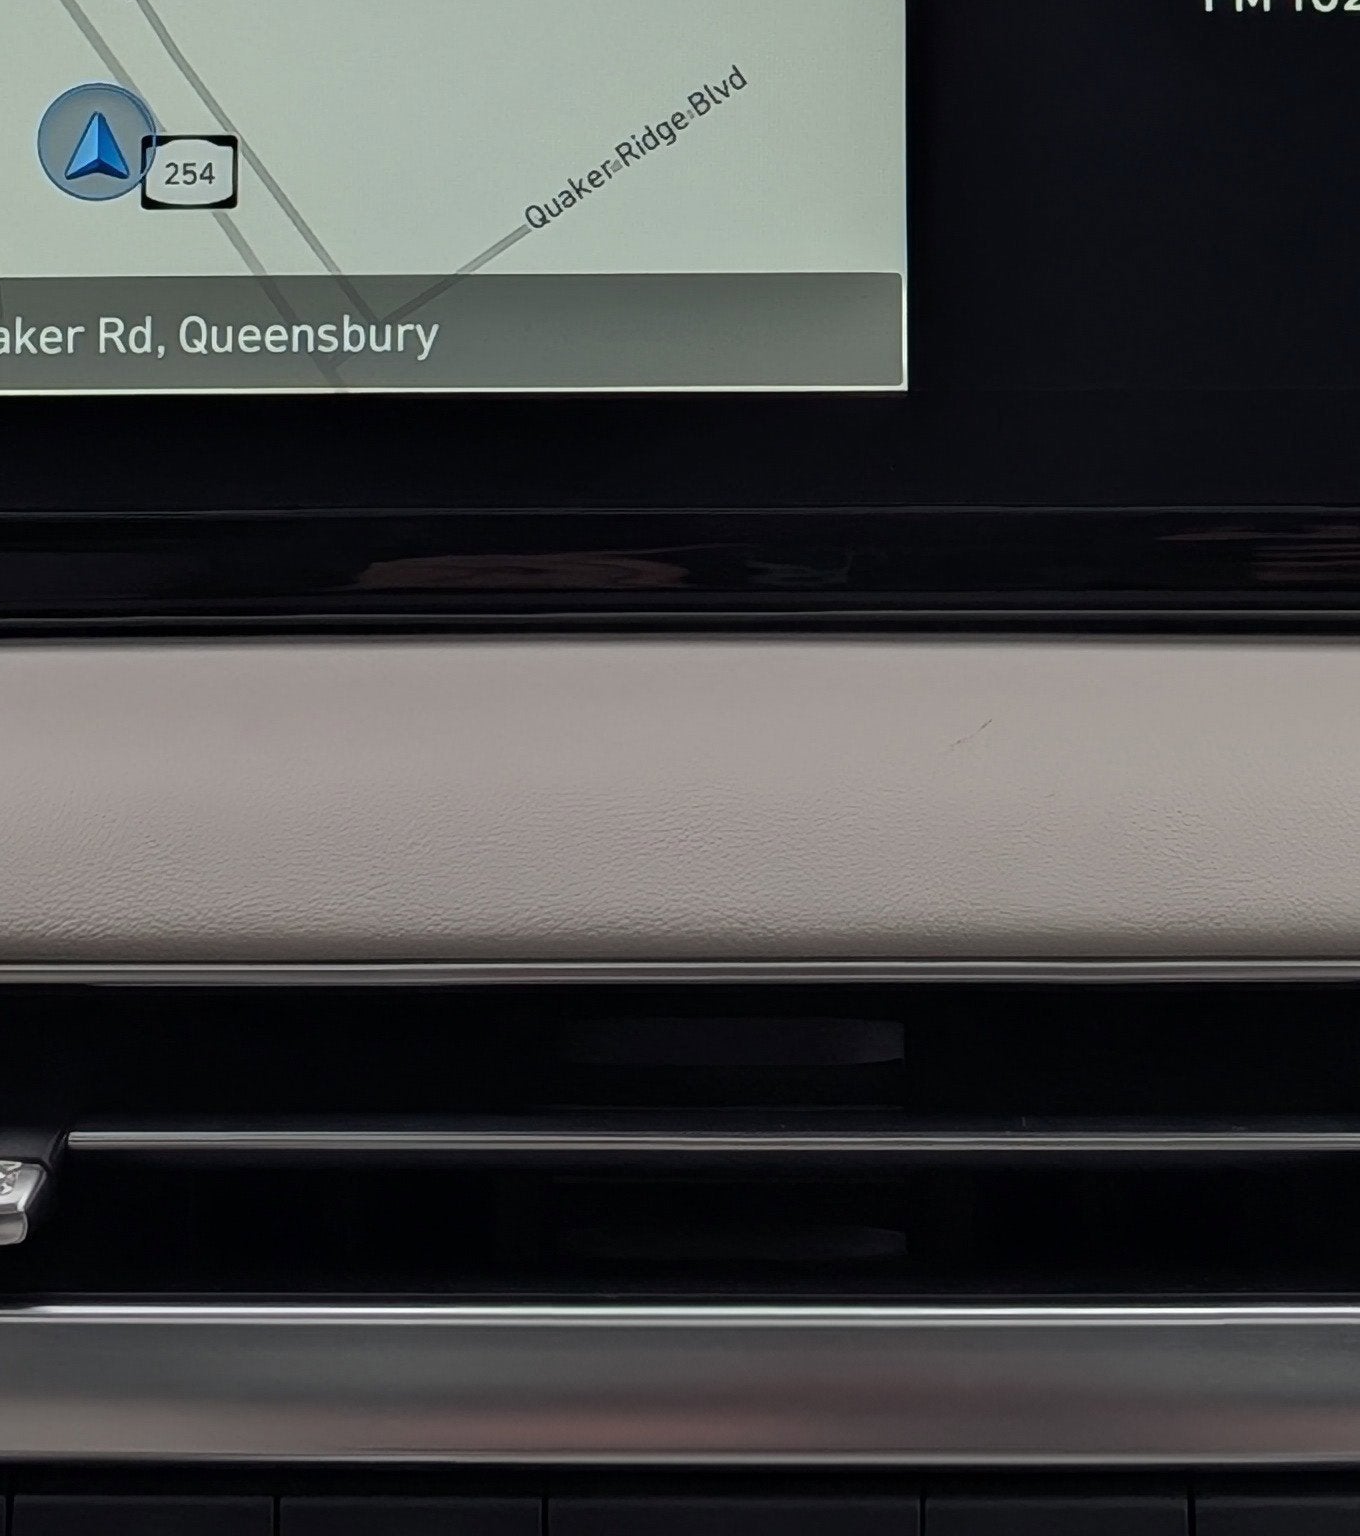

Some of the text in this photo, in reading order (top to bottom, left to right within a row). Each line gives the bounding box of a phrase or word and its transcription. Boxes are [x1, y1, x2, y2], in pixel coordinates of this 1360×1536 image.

[524, 63, 748, 229] Quaker Ridge Blvd
[164, 161, 216, 186] 254
[98, 315, 165, 359] Rd,
[178, 314, 440, 361] Queensbury
